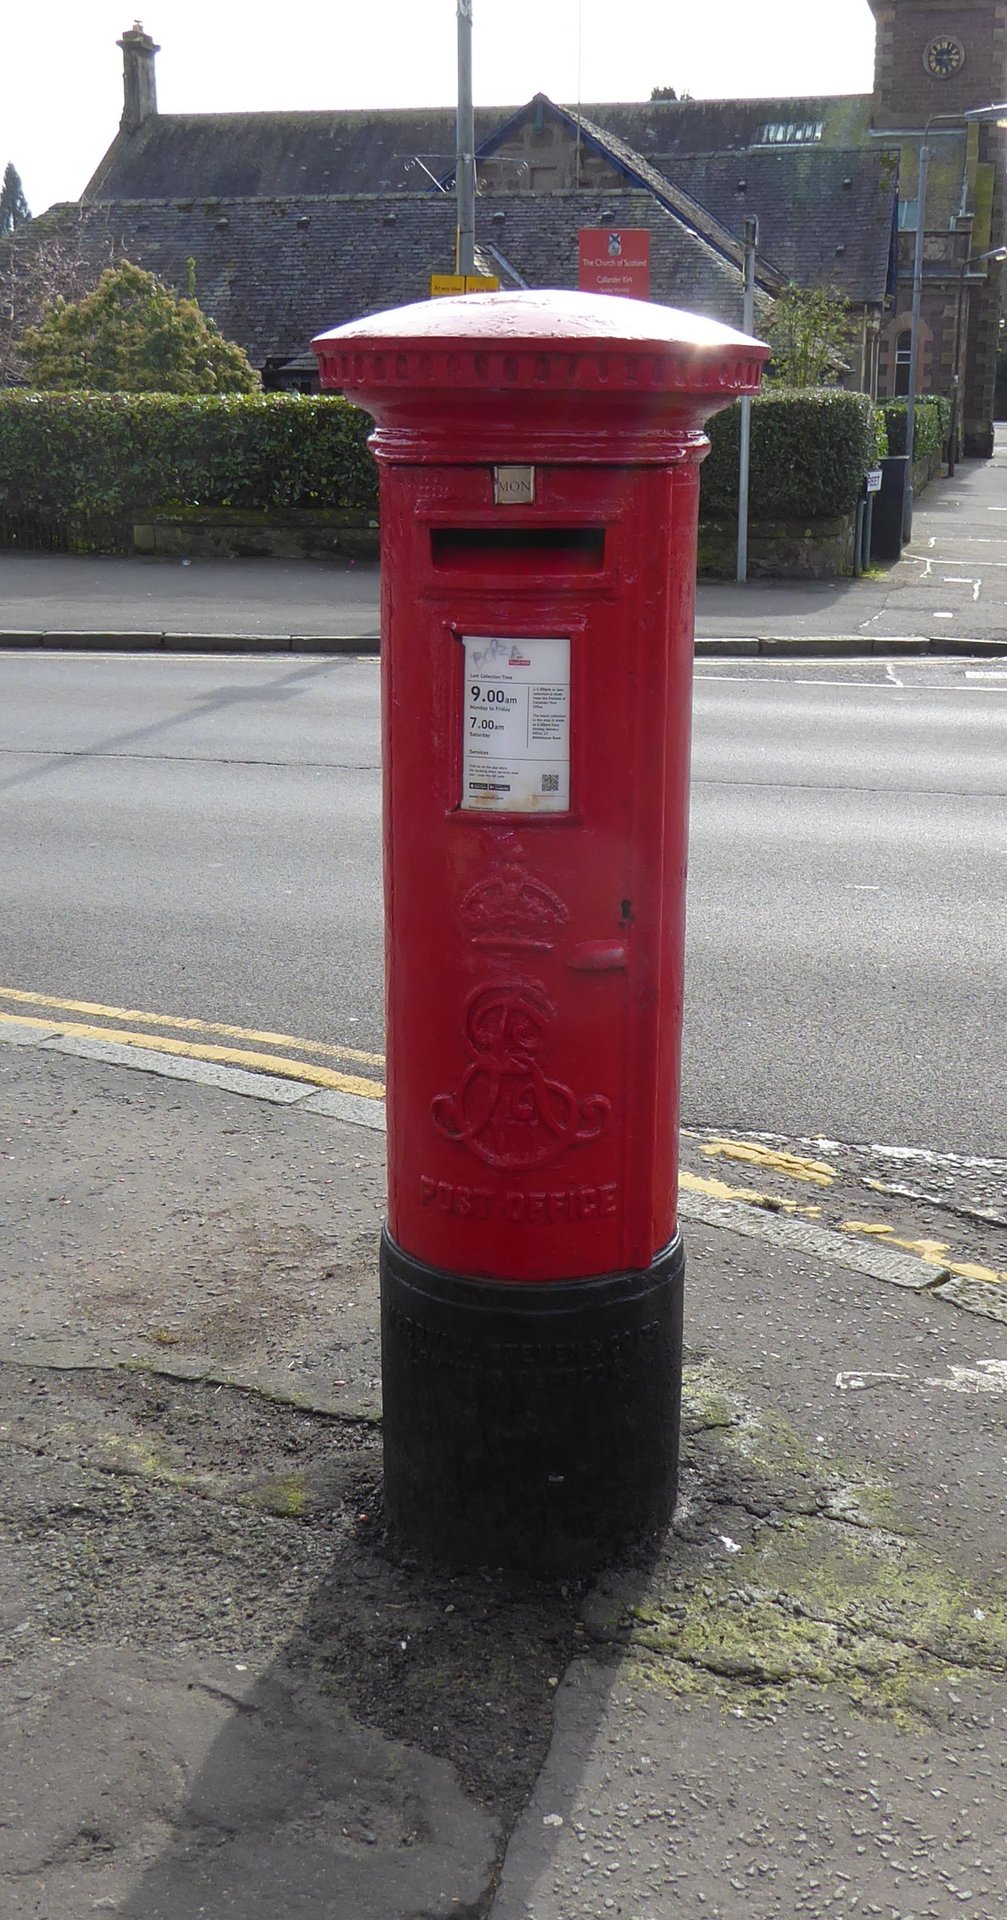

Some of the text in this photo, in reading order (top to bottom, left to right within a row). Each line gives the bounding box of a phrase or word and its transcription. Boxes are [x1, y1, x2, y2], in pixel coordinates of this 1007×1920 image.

[582, 258, 594, 267] The
[595, 258, 616, 267] Church
[624, 258, 647, 268] Scotland
[597, 275, 633, 284] Callander Kirk
[498, 481, 530, 492] MON
[471, 685, 517, 704] 9.00am
[470, 716, 505, 731] 7.00am
[420, 1174, 617, 1221] POST OFFICE
